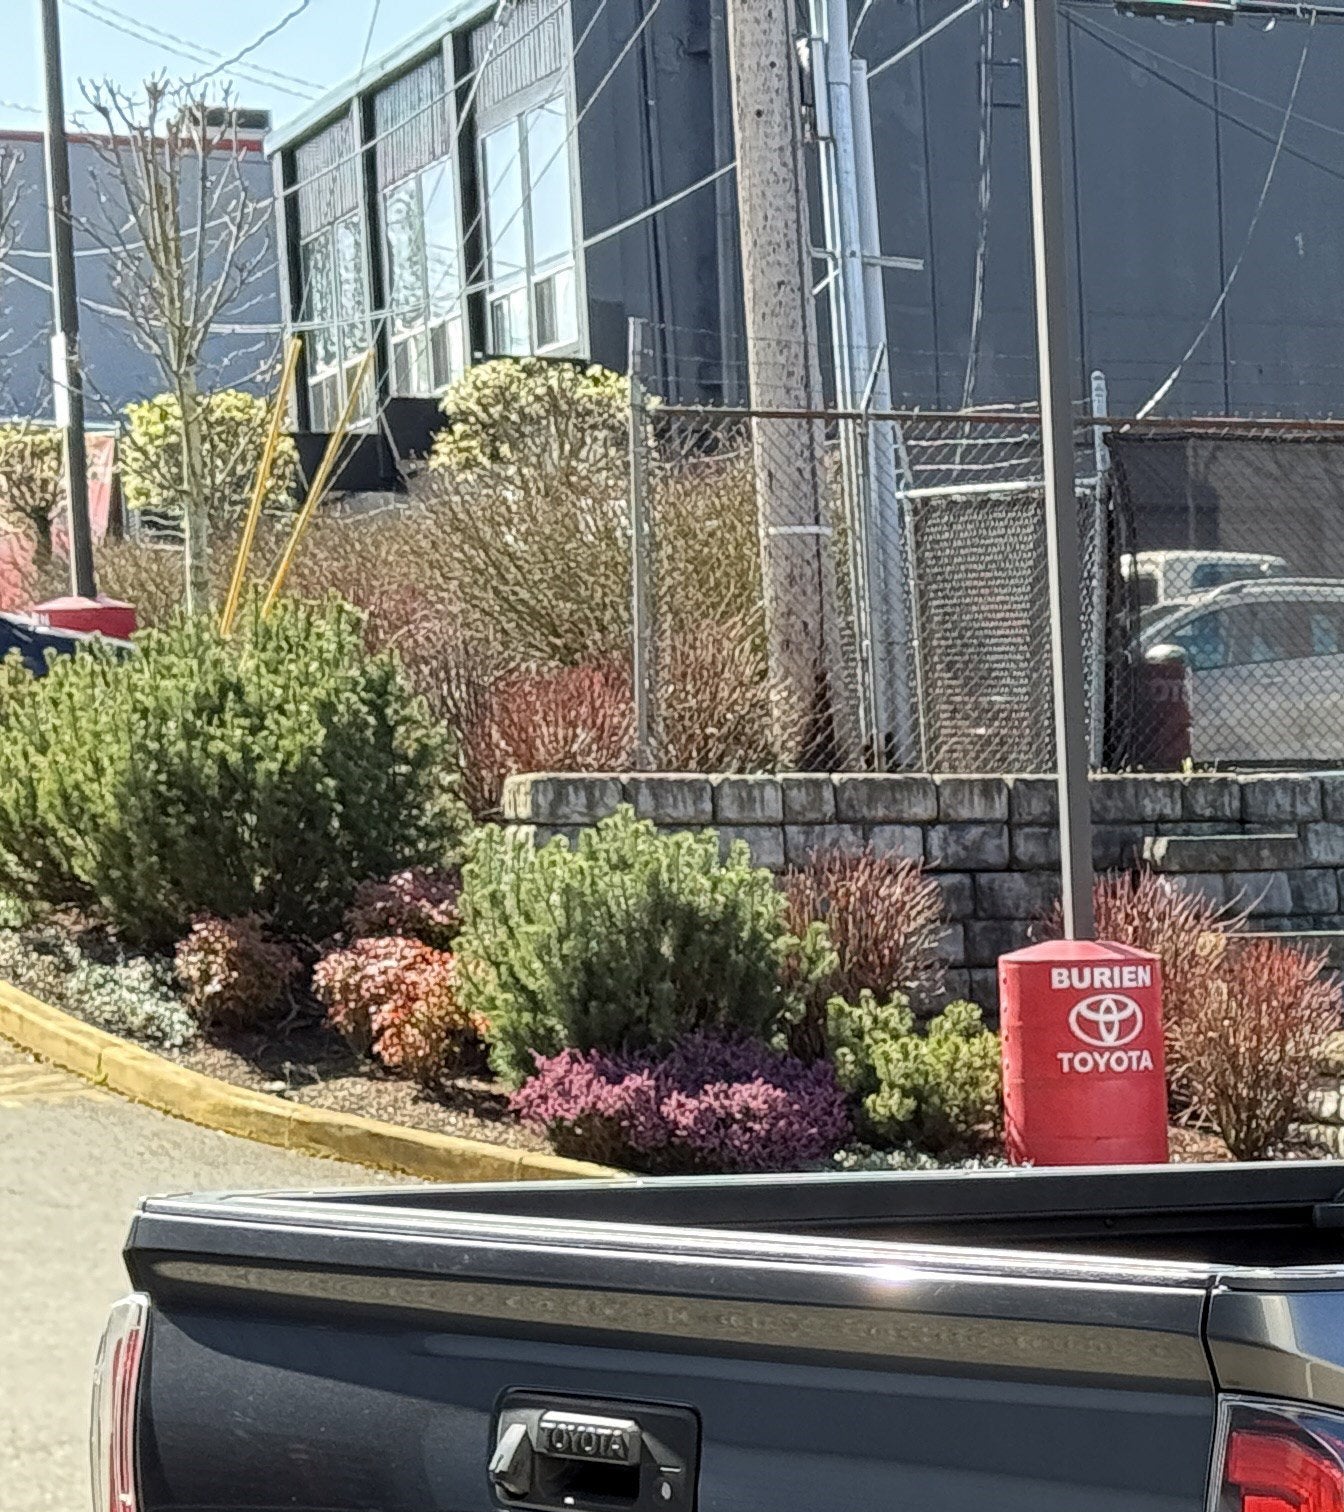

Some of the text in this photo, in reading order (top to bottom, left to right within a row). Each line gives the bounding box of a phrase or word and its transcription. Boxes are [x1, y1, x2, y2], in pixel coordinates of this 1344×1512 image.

[1051, 965, 1152, 990] BURIEN
[1056, 1050, 1154, 1073] TOYOTA
[539, 1420, 629, 1460] TOYOTA
